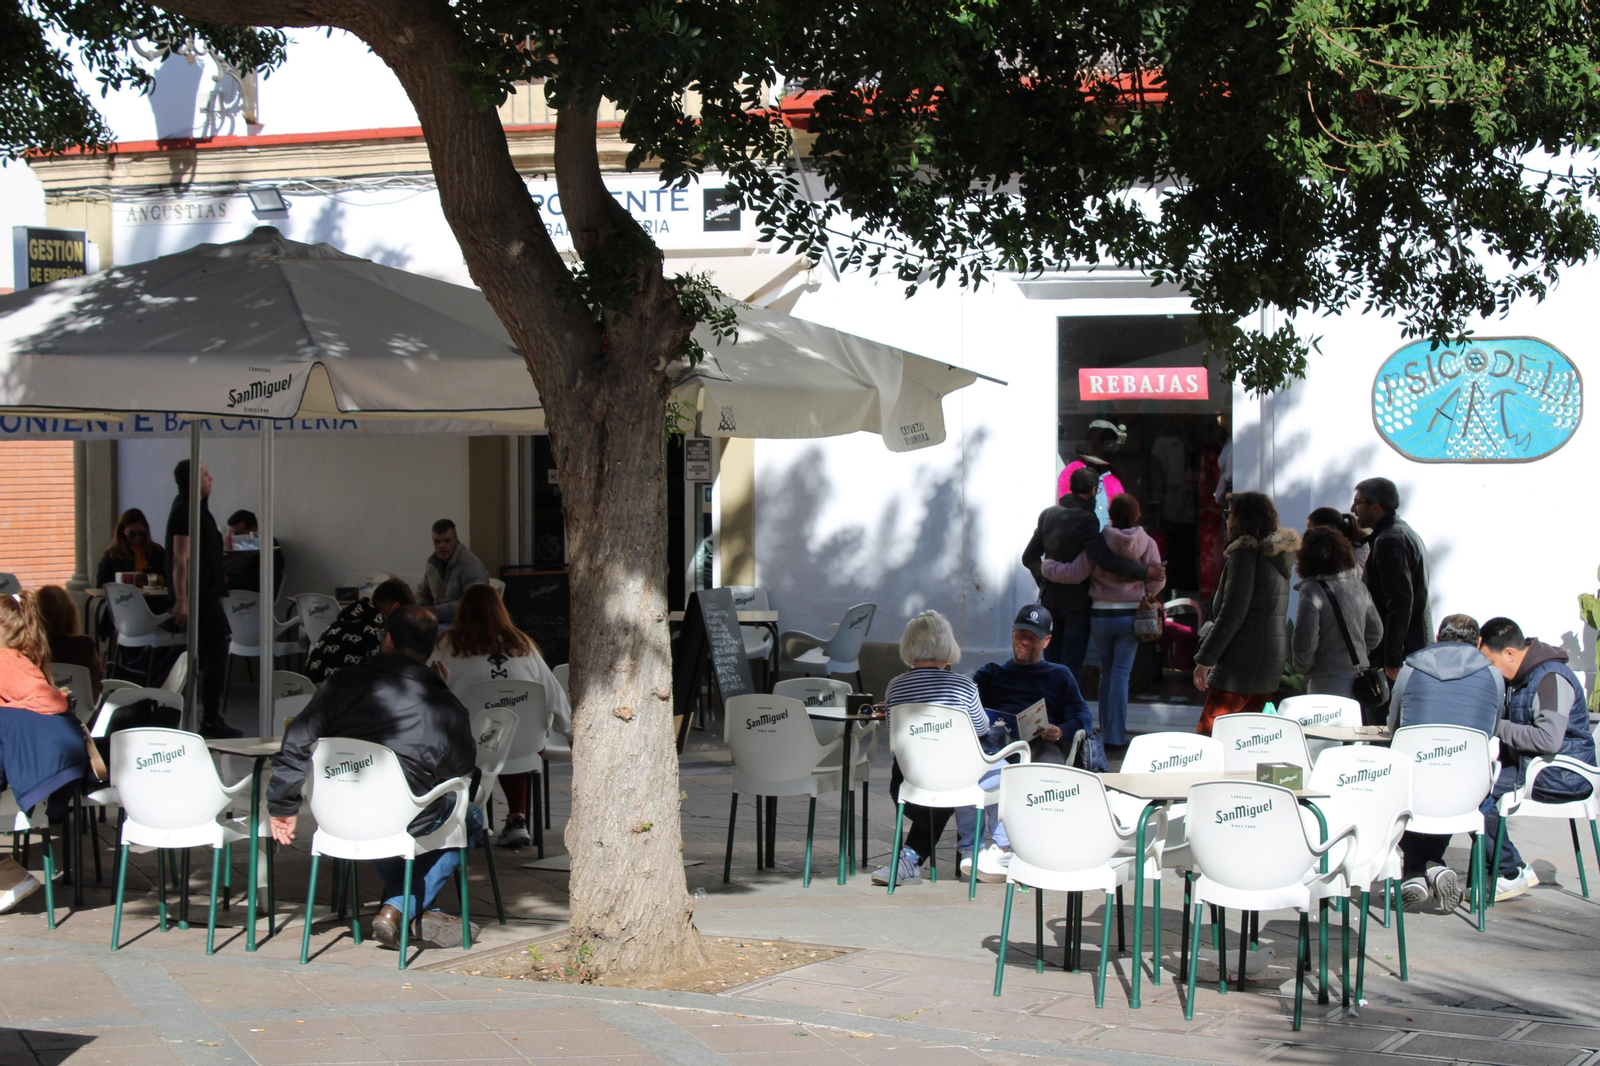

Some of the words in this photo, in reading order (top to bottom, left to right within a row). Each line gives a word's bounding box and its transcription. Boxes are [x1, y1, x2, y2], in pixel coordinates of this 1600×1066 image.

[126, 202, 227, 222] ANGUSTIAS
[29, 238, 84, 263] GESTION
[30, 268, 43, 283] DE
[226, 373, 292, 408] SanMiguel
[1089, 374, 1199, 394] REBAJAS
[1427, 382, 1530, 451] ART
[745, 709, 789, 730] SanMiguel
[909, 718, 952, 737] SanMiguel
[1235, 729, 1283, 751] SanMiguel
[1414, 740, 1467, 763] SanMiguel
[136, 744, 186, 770] SanMiguel
[324, 754, 374, 780] SanMiguel
[1149, 749, 1203, 773] SanMiguel
[1336, 763, 1392, 787] SanMiguel
[1025, 783, 1080, 807] SanMiguel
[1214, 798, 1273, 825] SanMiguel
